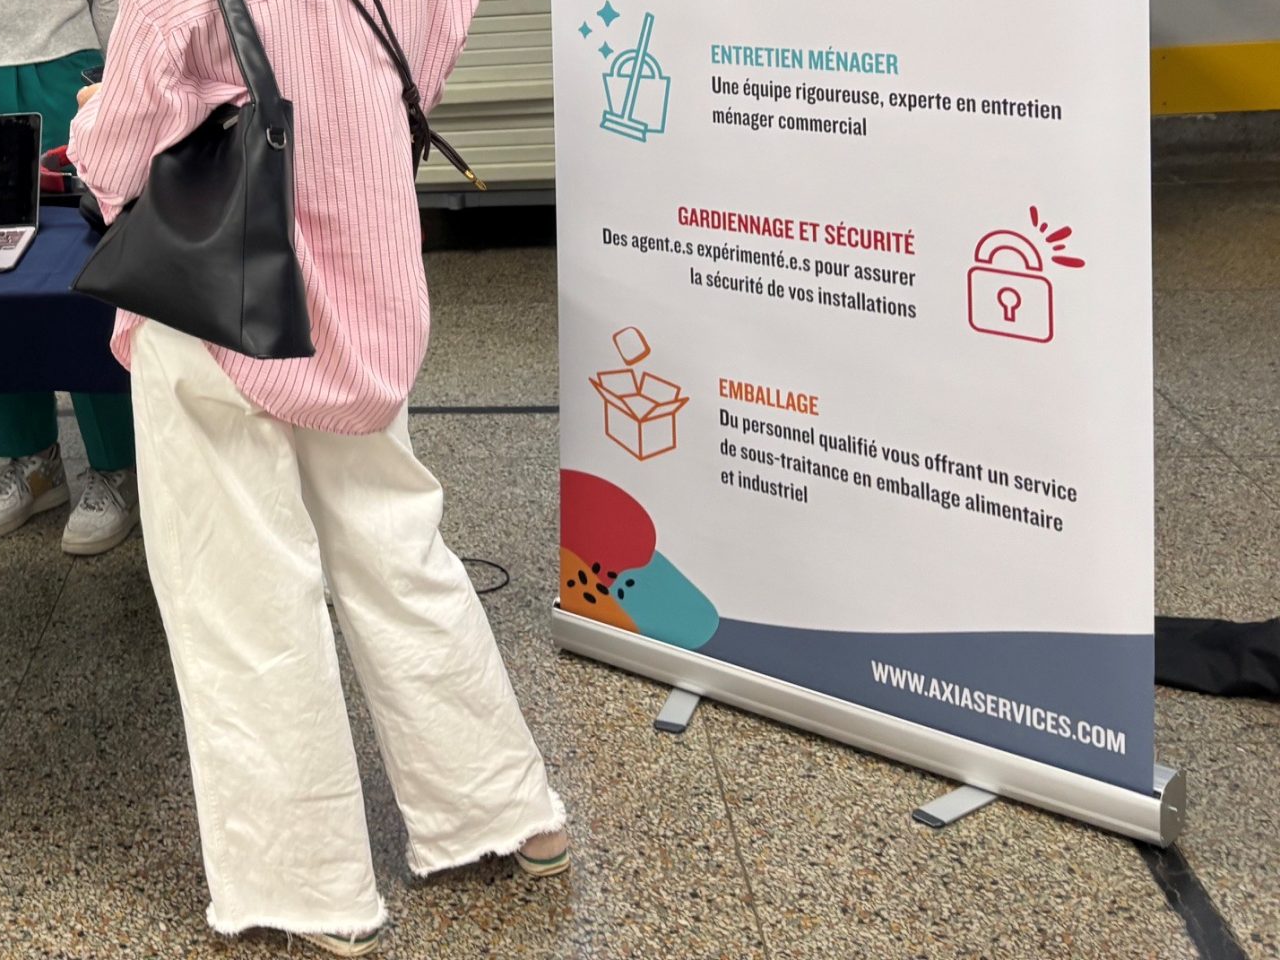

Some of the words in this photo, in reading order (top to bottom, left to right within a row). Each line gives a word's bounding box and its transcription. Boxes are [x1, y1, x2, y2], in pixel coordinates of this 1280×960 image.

[711, 45, 803, 69] ENTRETIEN
[809, 46, 898, 74] MÉNAGER
[712, 76, 738, 95] Une
[743, 78, 791, 102] équipe
[796, 83, 883, 107] rigoureuse,
[889, 93, 951, 111] experte
[957, 98, 976, 112] en
[982, 99, 1061, 120] entretien
[713, 107, 774, 130] ménager
[779, 116, 866, 136] commercial
[678, 207, 794, 239] GARDIENNAGE
[800, 221, 820, 242] ET
[825, 222, 915, 255] SÉCURITÉ
[603, 228, 627, 246] Des
[632, 236, 693, 255] agent.e.s
[697, 243, 810, 271] expérimenté.e.s
[815, 260, 849, 277] pour
[855, 266, 915, 286] assurer
[691, 267, 702, 285] la
[706, 271, 763, 294] sécurité
[768, 280, 784, 298] de
[789, 287, 813, 302] vos
[819, 287, 916, 318] installations
[719, 378, 819, 415] EMBALLAGE
[720, 409, 738, 428] Du
[743, 418, 814, 445] personnel
[819, 428, 877, 458] qualifié
[882, 447, 919, 467] vous
[925, 454, 982, 480] offrant
[988, 469, 1008, 486] un
[1015, 471, 1077, 502] service
[721, 439, 736, 457] de
[740, 444, 848, 482] sous-traitance
[854, 466, 871, 488] en
[877, 473, 960, 508] emballage
[966, 491, 1063, 532] alimentaire
[721, 471, 734, 485] et
[739, 471, 807, 503] industriel
[872, 661, 1125, 754] WWW.AXIASERVICES.COM
